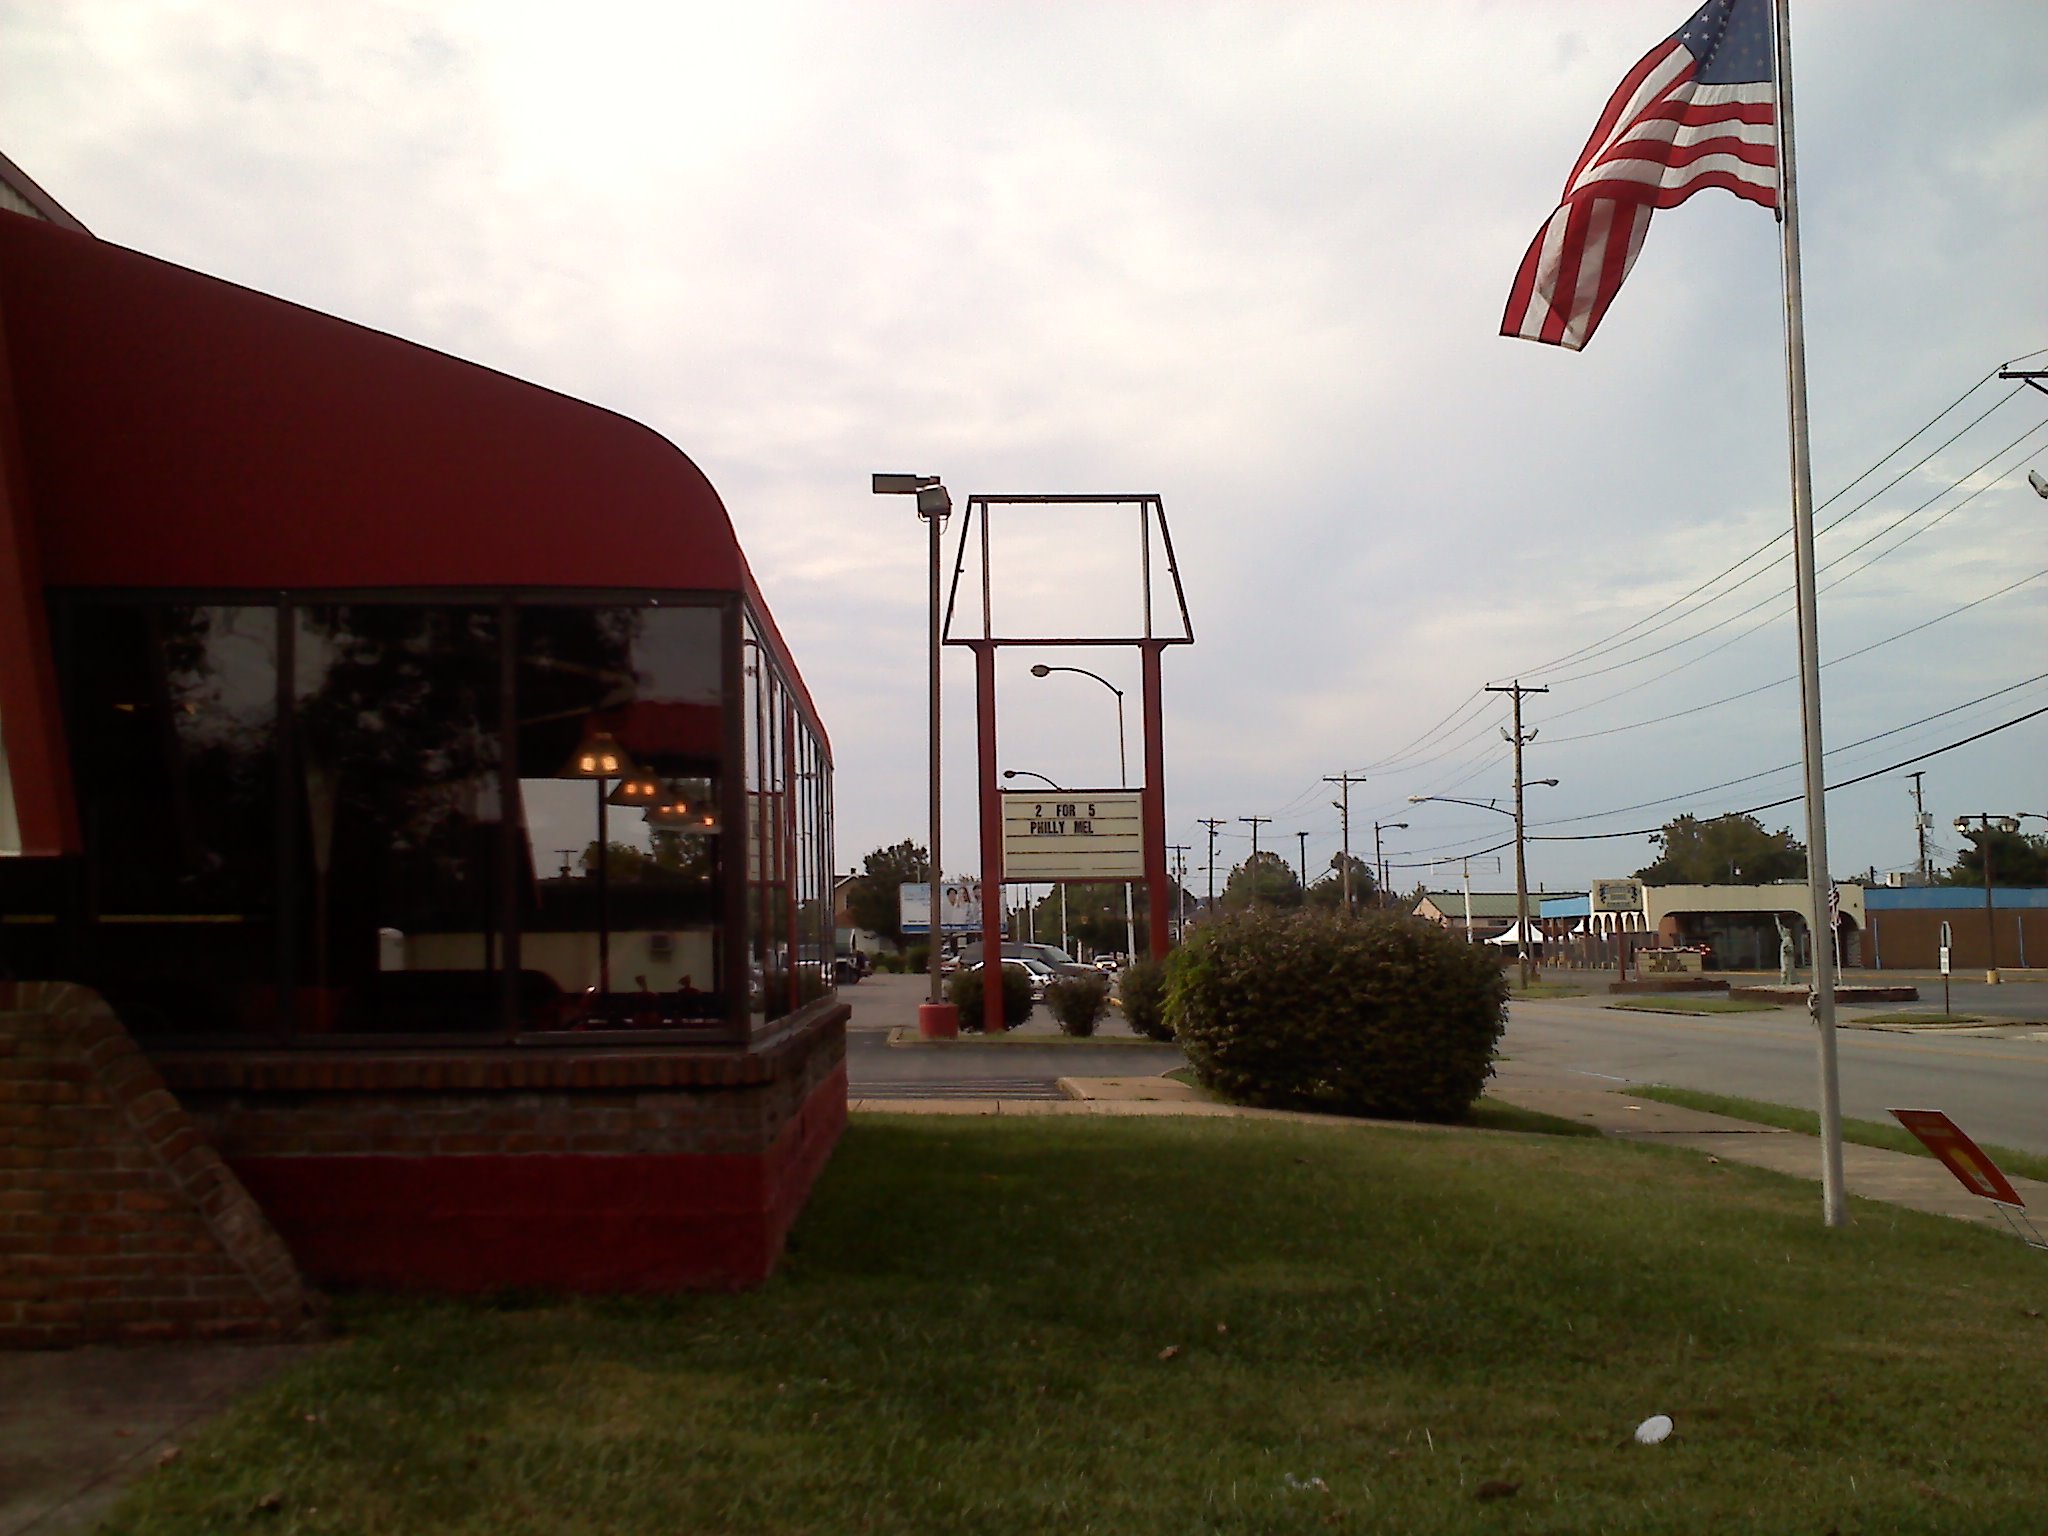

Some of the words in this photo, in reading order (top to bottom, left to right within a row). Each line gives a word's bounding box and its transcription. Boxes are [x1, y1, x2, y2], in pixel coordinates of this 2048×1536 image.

[1035, 804, 1042, 817] 2
[1056, 804, 1076, 817] FOR
[1088, 804, 1096, 817] 5
[1030, 821, 1065, 834] PHILLY
[1074, 821, 1094, 834] MEL
